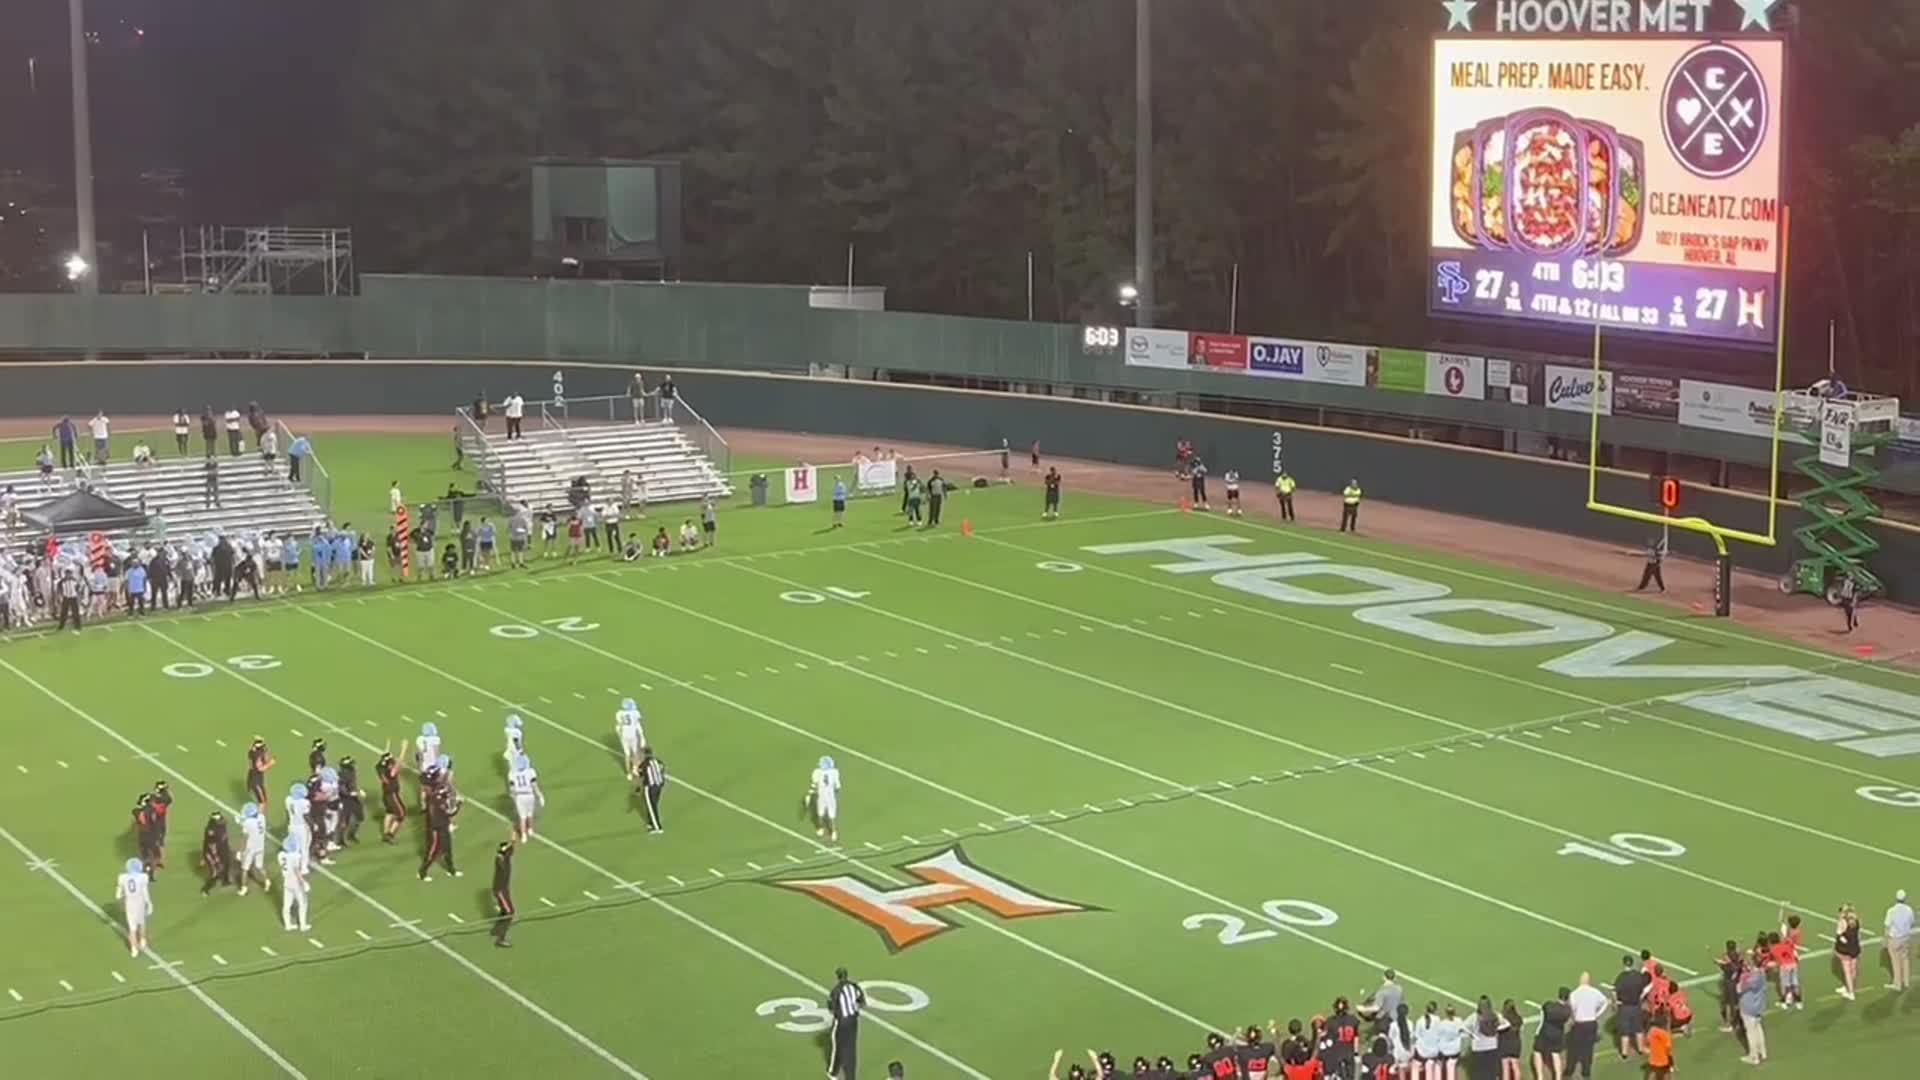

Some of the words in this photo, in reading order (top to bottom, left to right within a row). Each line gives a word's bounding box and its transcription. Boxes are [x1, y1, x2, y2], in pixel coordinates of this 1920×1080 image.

[1495, 1, 1632, 31] HOOVER
[1639, 1, 1711, 31] MET
[1451, 62, 1493, 88] MEAL
[1498, 63, 1542, 88] PREP.
[1548, 63, 1595, 90] MADE
[1600, 64, 1650, 91] EASY.
[1649, 192, 1776, 222] CLEANEATZ.COM
[1475, 269, 1504, 299] 27
[1532, 261, 1561, 281] 4TH
[1572, 258, 1625, 293] 6:03
[1531, 293, 1557, 313] 4TH
[1695, 287, 1728, 320] 27
[1085, 325, 1120, 347] 6:03
[1252, 345, 1301, 365] O.JAY
[1549, 374, 1608, 404] Culve's
[1272, 431, 1283, 474] 375
[793, 468, 809, 491] H
[1078, 534, 1920, 758] HOOVE
[1556, 832, 1687, 865] 10
[1182, 899, 1339, 945] 20
[755, 980, 930, 1033] 30
